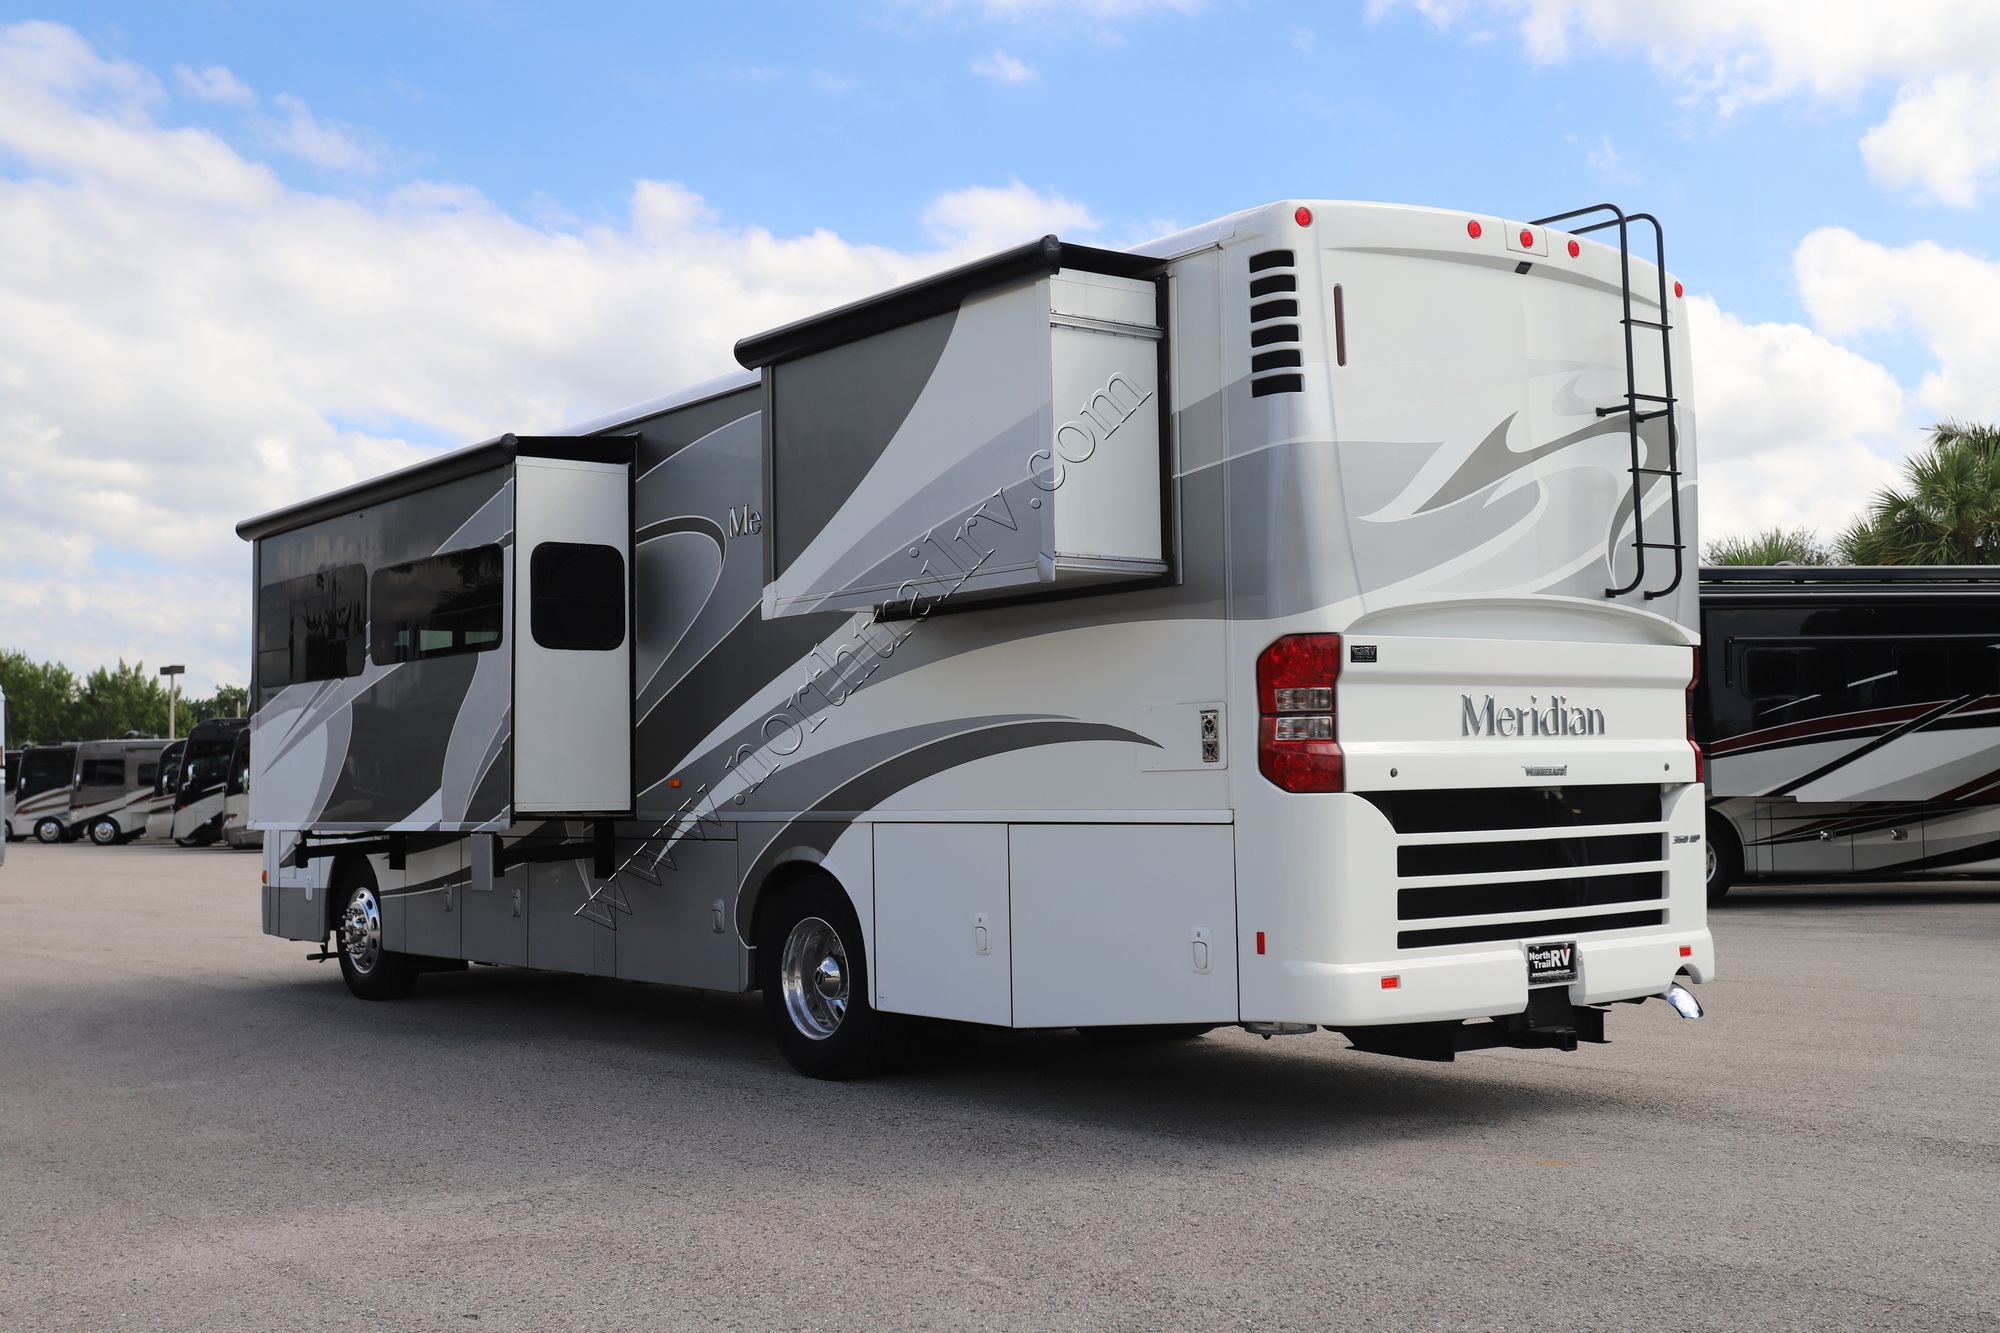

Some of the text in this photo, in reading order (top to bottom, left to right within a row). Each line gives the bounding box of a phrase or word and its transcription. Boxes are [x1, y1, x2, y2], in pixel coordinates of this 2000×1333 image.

[1461, 694, 1606, 736] Meridian
[1529, 951, 1551, 961] North
[1550, 948, 1571, 967] RV
[1533, 960, 1551, 969] Trail
